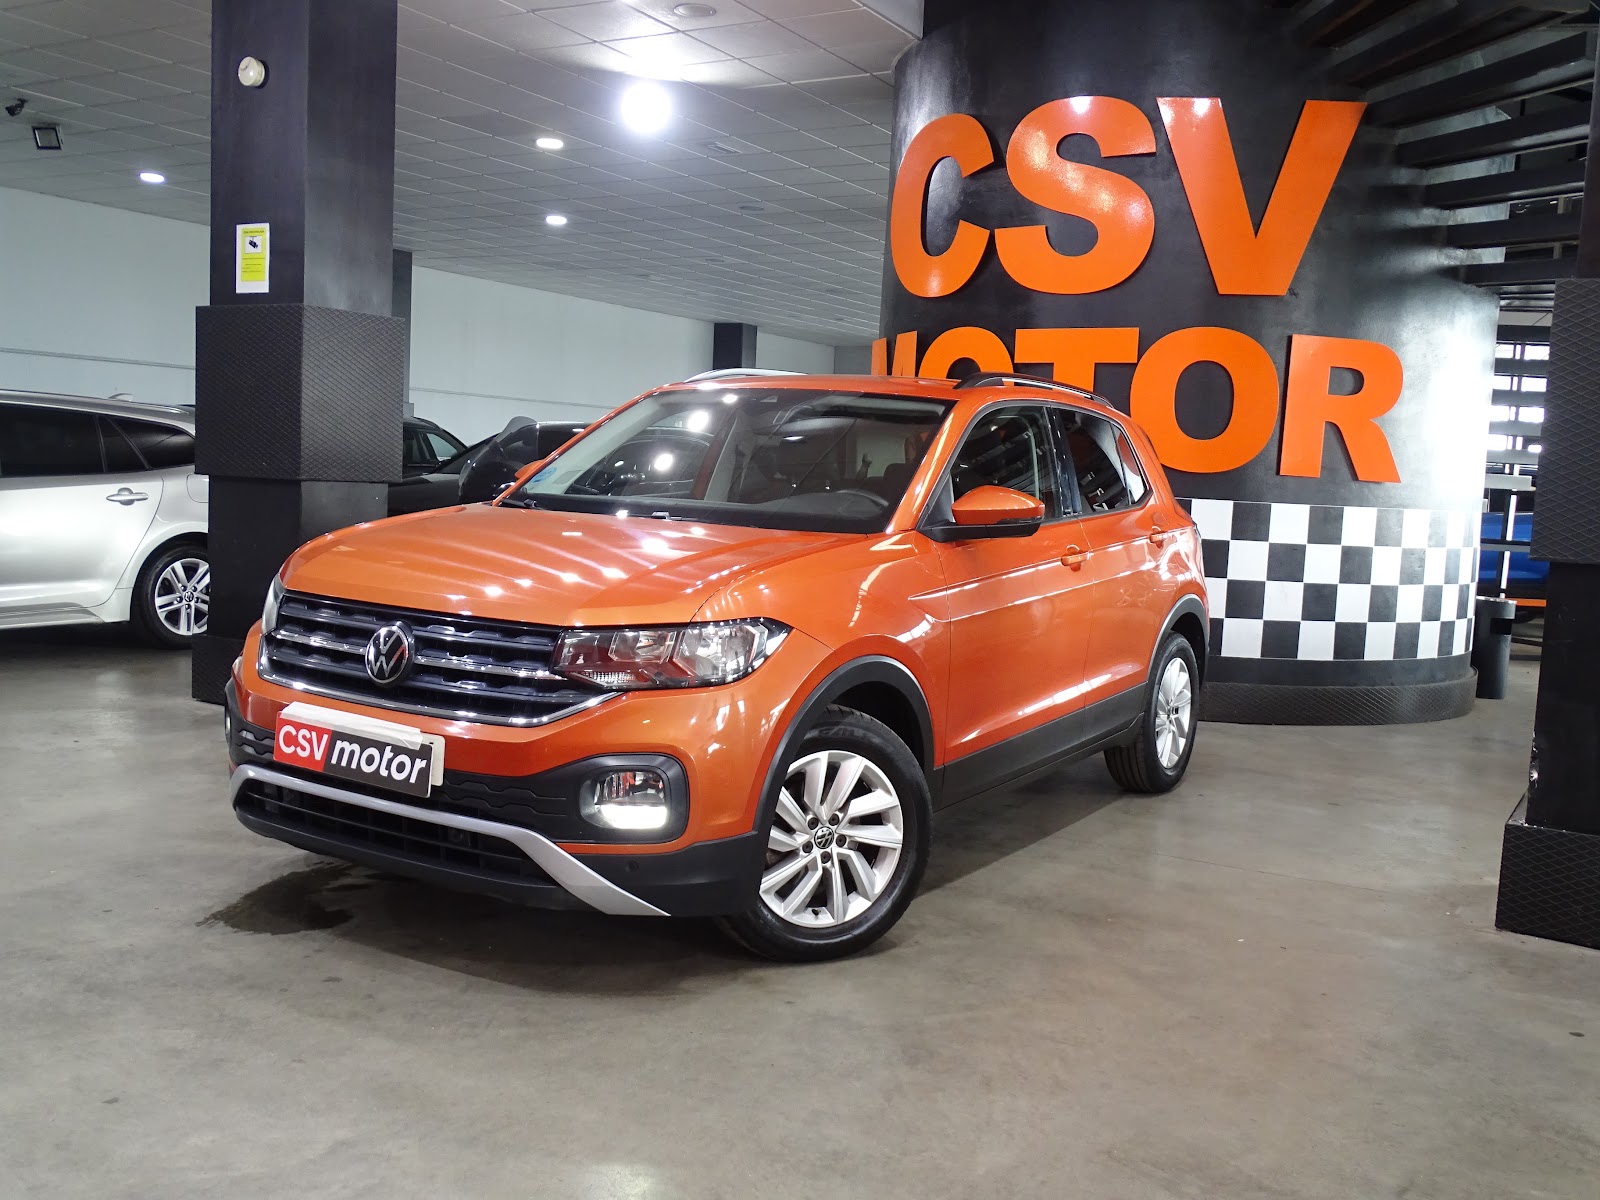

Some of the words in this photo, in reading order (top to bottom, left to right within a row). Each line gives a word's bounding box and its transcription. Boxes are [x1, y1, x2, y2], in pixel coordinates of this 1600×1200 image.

[890, 95, 1367, 297] CSV
[871, 326, 1404, 483] TOR
[366, 625, 409, 682] VW
[278, 724, 329, 761] CSV
[330, 739, 427, 784] motor
